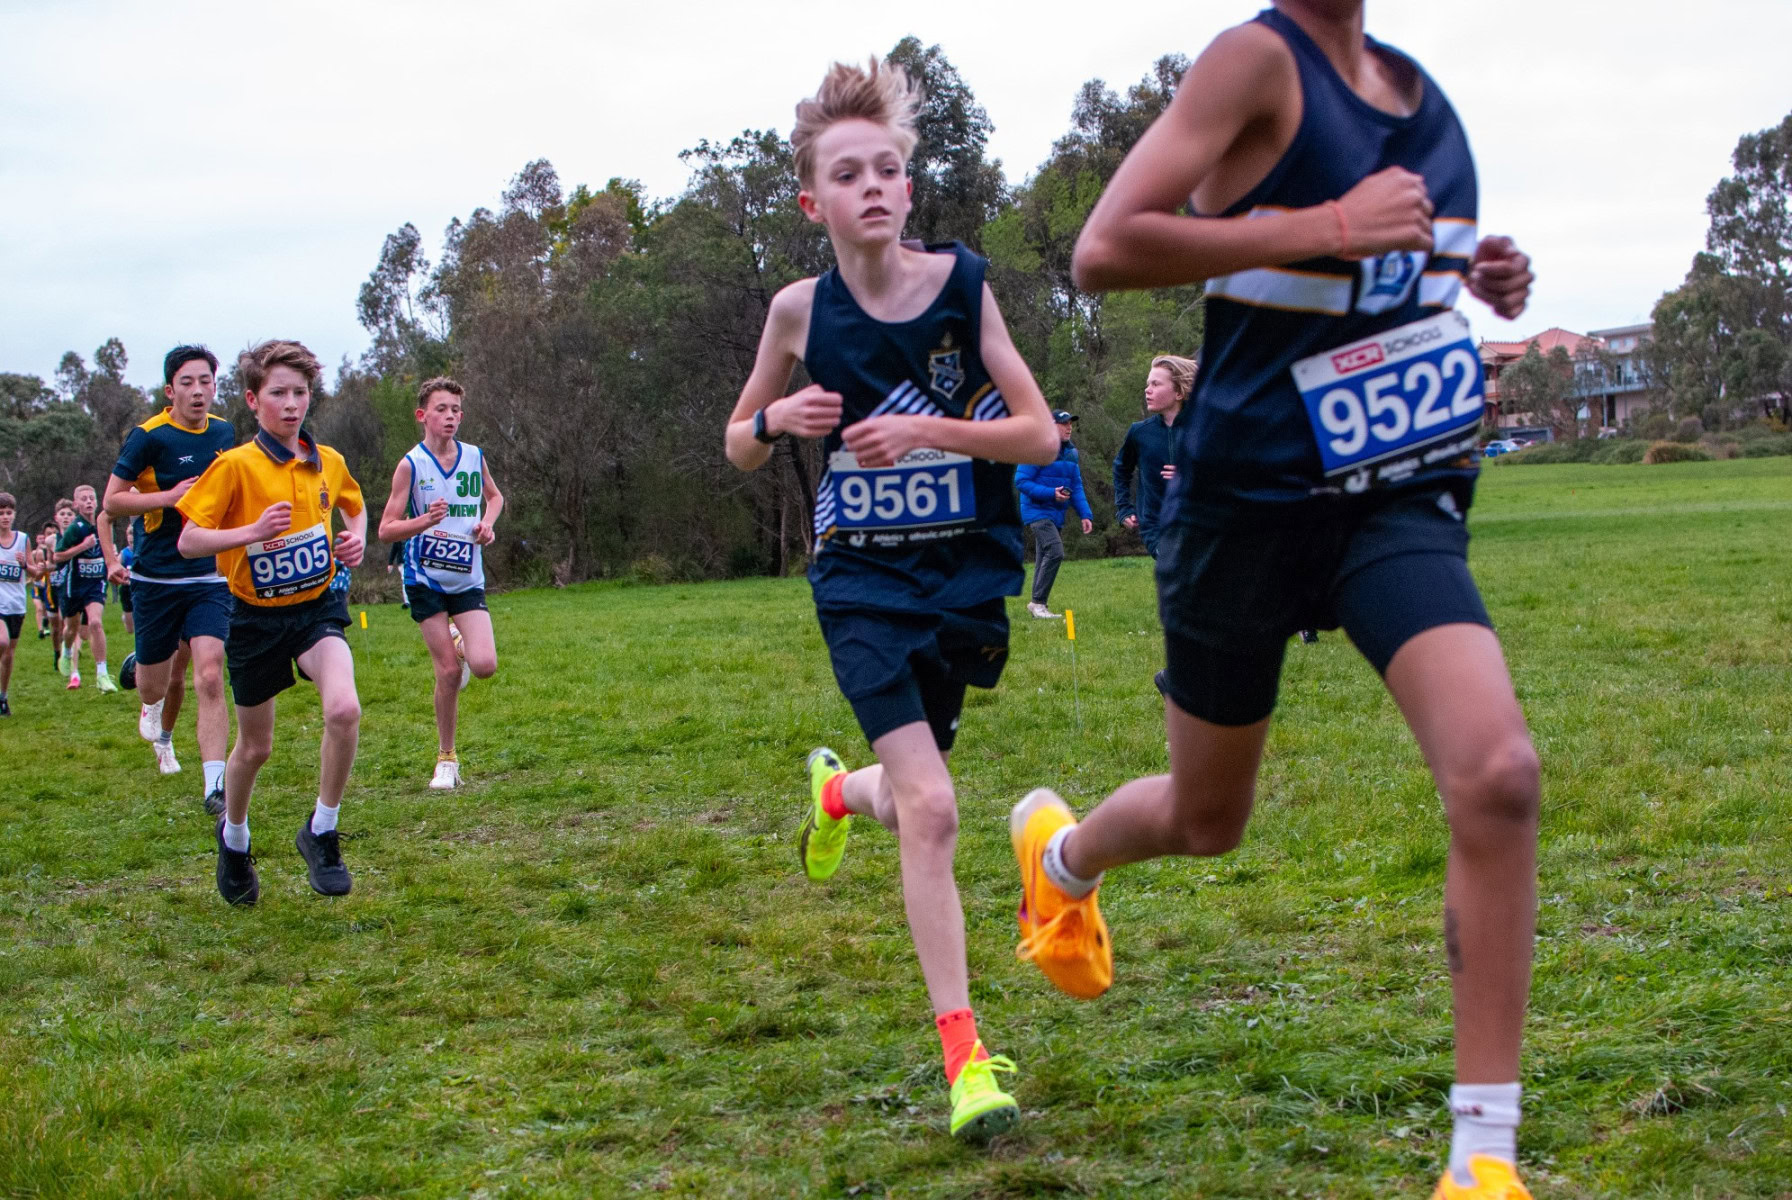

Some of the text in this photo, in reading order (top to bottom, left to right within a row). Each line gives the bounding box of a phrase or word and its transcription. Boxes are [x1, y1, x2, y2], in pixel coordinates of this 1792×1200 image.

[1319, 349, 1483, 456] 9522
[456, 471, 481, 497] 30
[840, 468, 960, 521] 9561
[264, 531, 314, 550] XCR SCHOOLS
[425, 537, 471, 562] 7524
[0, 565, 20, 578] 518
[79, 563, 103, 574] 9507
[254, 540, 329, 583] 9505
